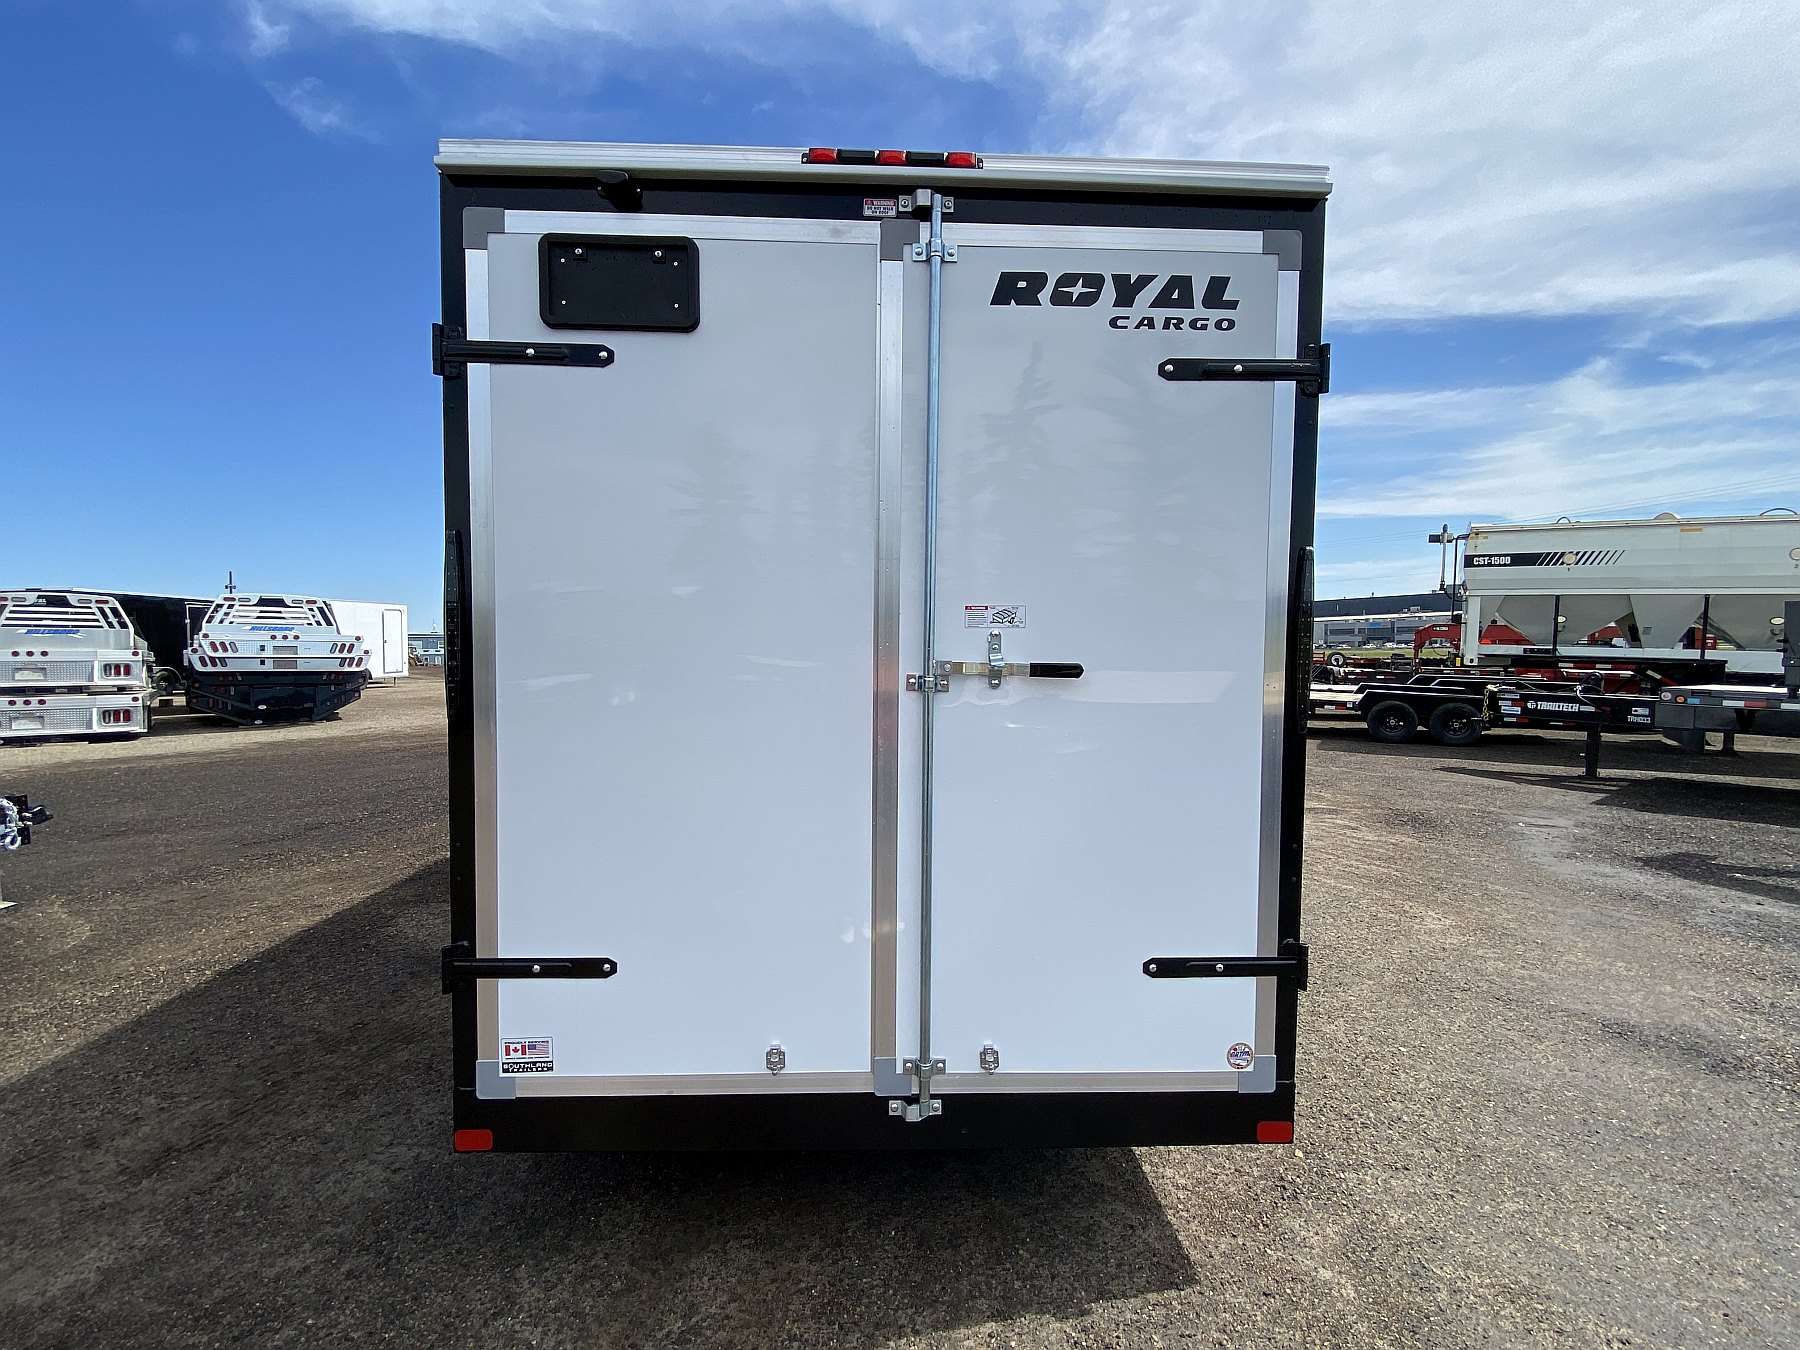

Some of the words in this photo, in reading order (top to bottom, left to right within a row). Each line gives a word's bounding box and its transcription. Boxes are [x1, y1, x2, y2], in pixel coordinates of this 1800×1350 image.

[989, 271, 1240, 311] ROYAL
[1108, 315, 1237, 332] CARGO
[1473, 556, 1511, 565] CST-1500
[1537, 701, 1579, 712] TRAILTECH
